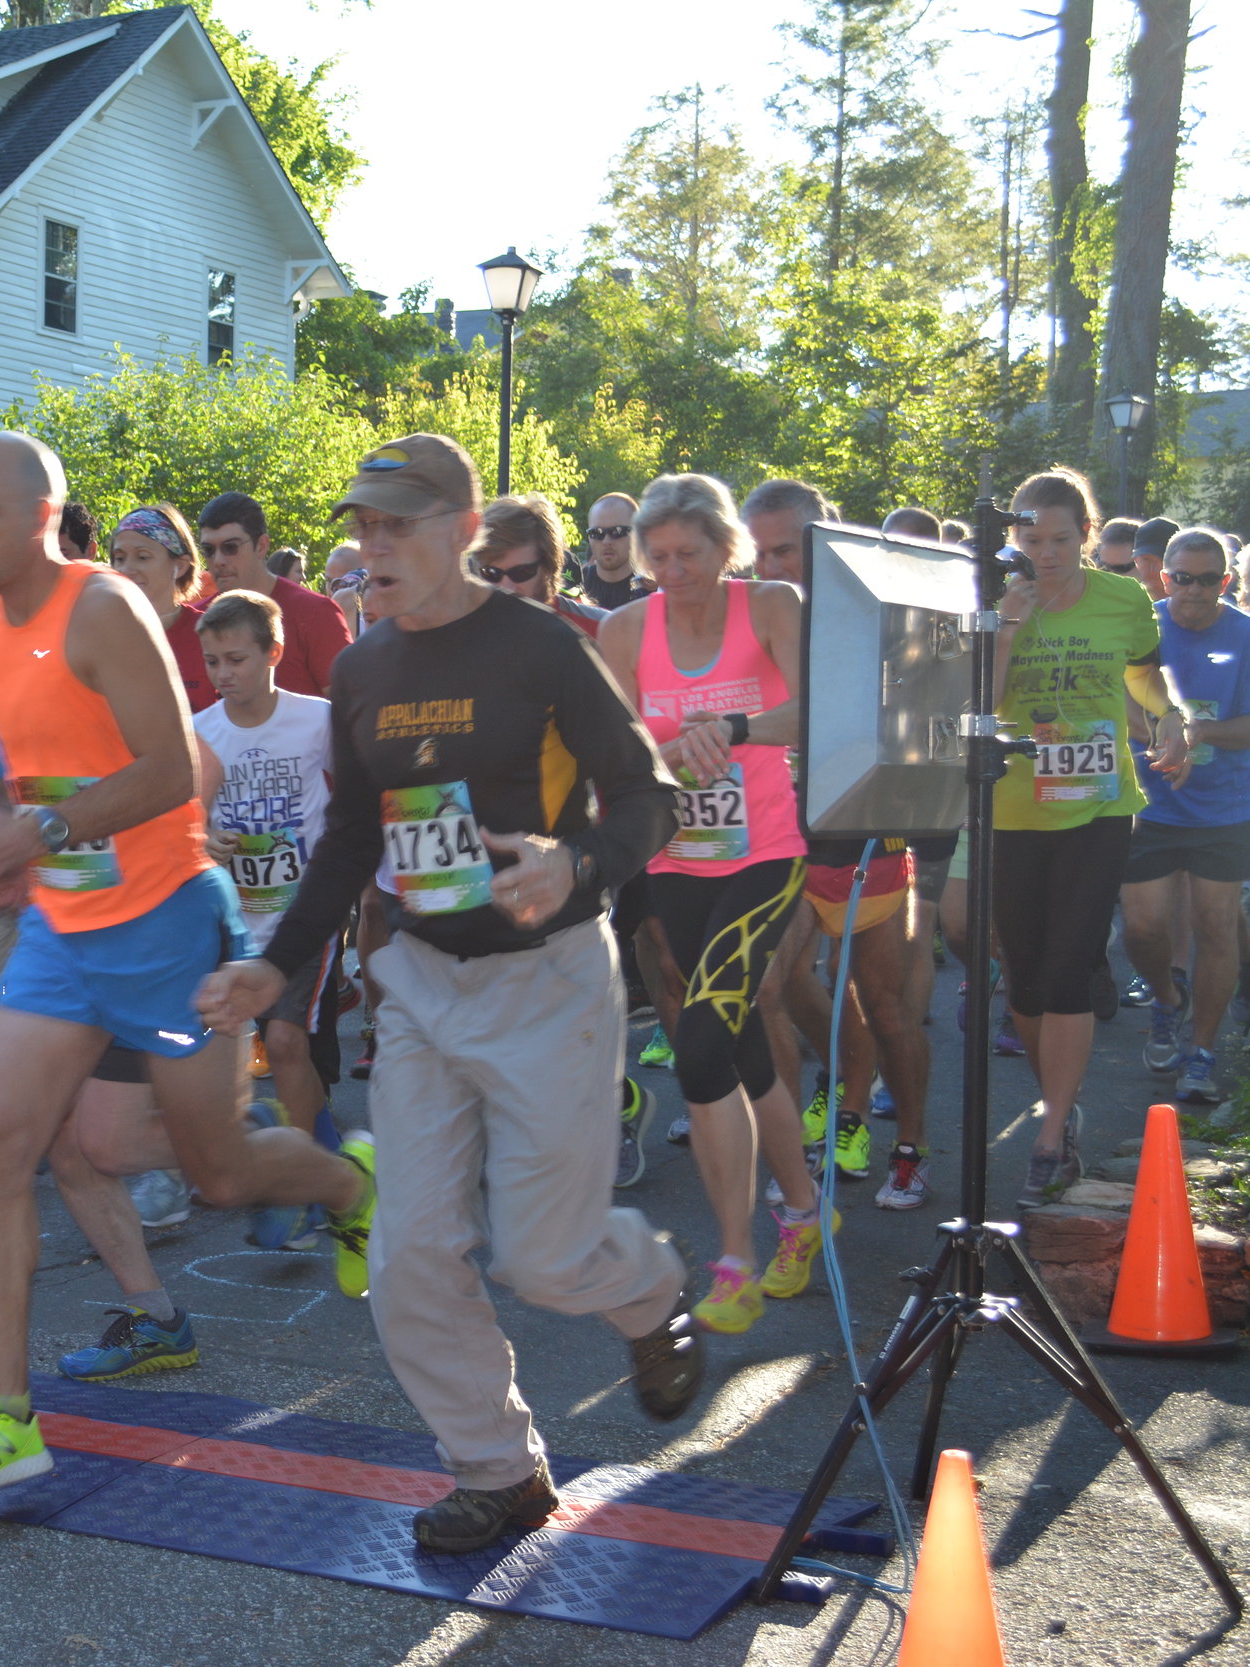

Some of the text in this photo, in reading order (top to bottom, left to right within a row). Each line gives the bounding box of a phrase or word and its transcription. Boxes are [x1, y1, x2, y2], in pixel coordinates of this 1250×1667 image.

[1036, 636, 1090, 649] Stick Boy
[1010, 650, 1114, 667] Mayview Madness
[1047, 666, 1079, 692] 5k
[680, 684, 761, 704] LOS ANGELES
[680, 692, 763, 714] MARATHON
[375, 698, 475, 731] APPALACHIAN
[374, 722, 475, 741] ATHLETICS
[252, 757, 302, 779] FAST
[1038, 743, 1114, 775] 1925
[249, 775, 303, 799] HARD
[218, 793, 304, 824] SCORE
[389, 816, 483, 870] 1734
[229, 851, 300, 887] 1973
